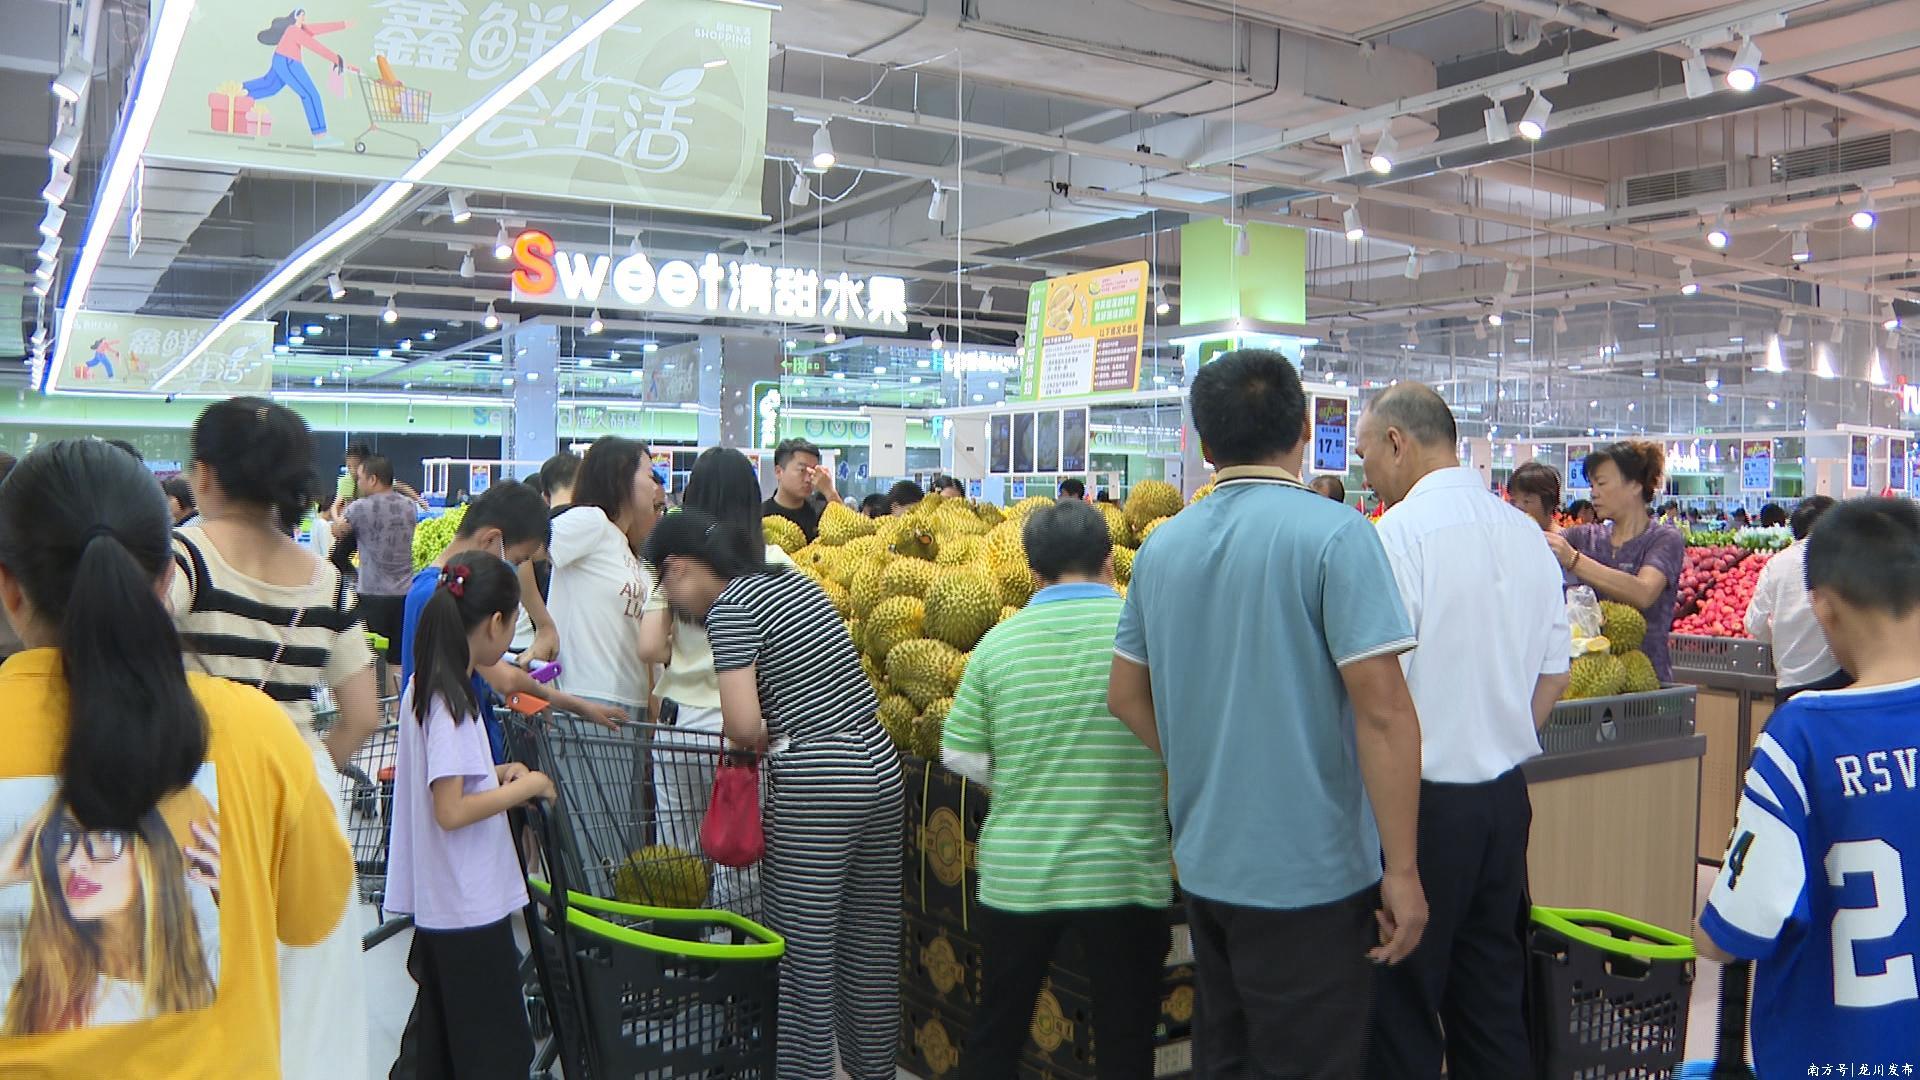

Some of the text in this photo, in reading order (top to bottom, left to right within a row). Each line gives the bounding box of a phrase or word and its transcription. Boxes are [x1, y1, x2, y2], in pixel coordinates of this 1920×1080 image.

[513, 230, 724, 309] Sweet
[1834, 747, 1919, 797] RSV
[1823, 838, 1919, 1008] 2
